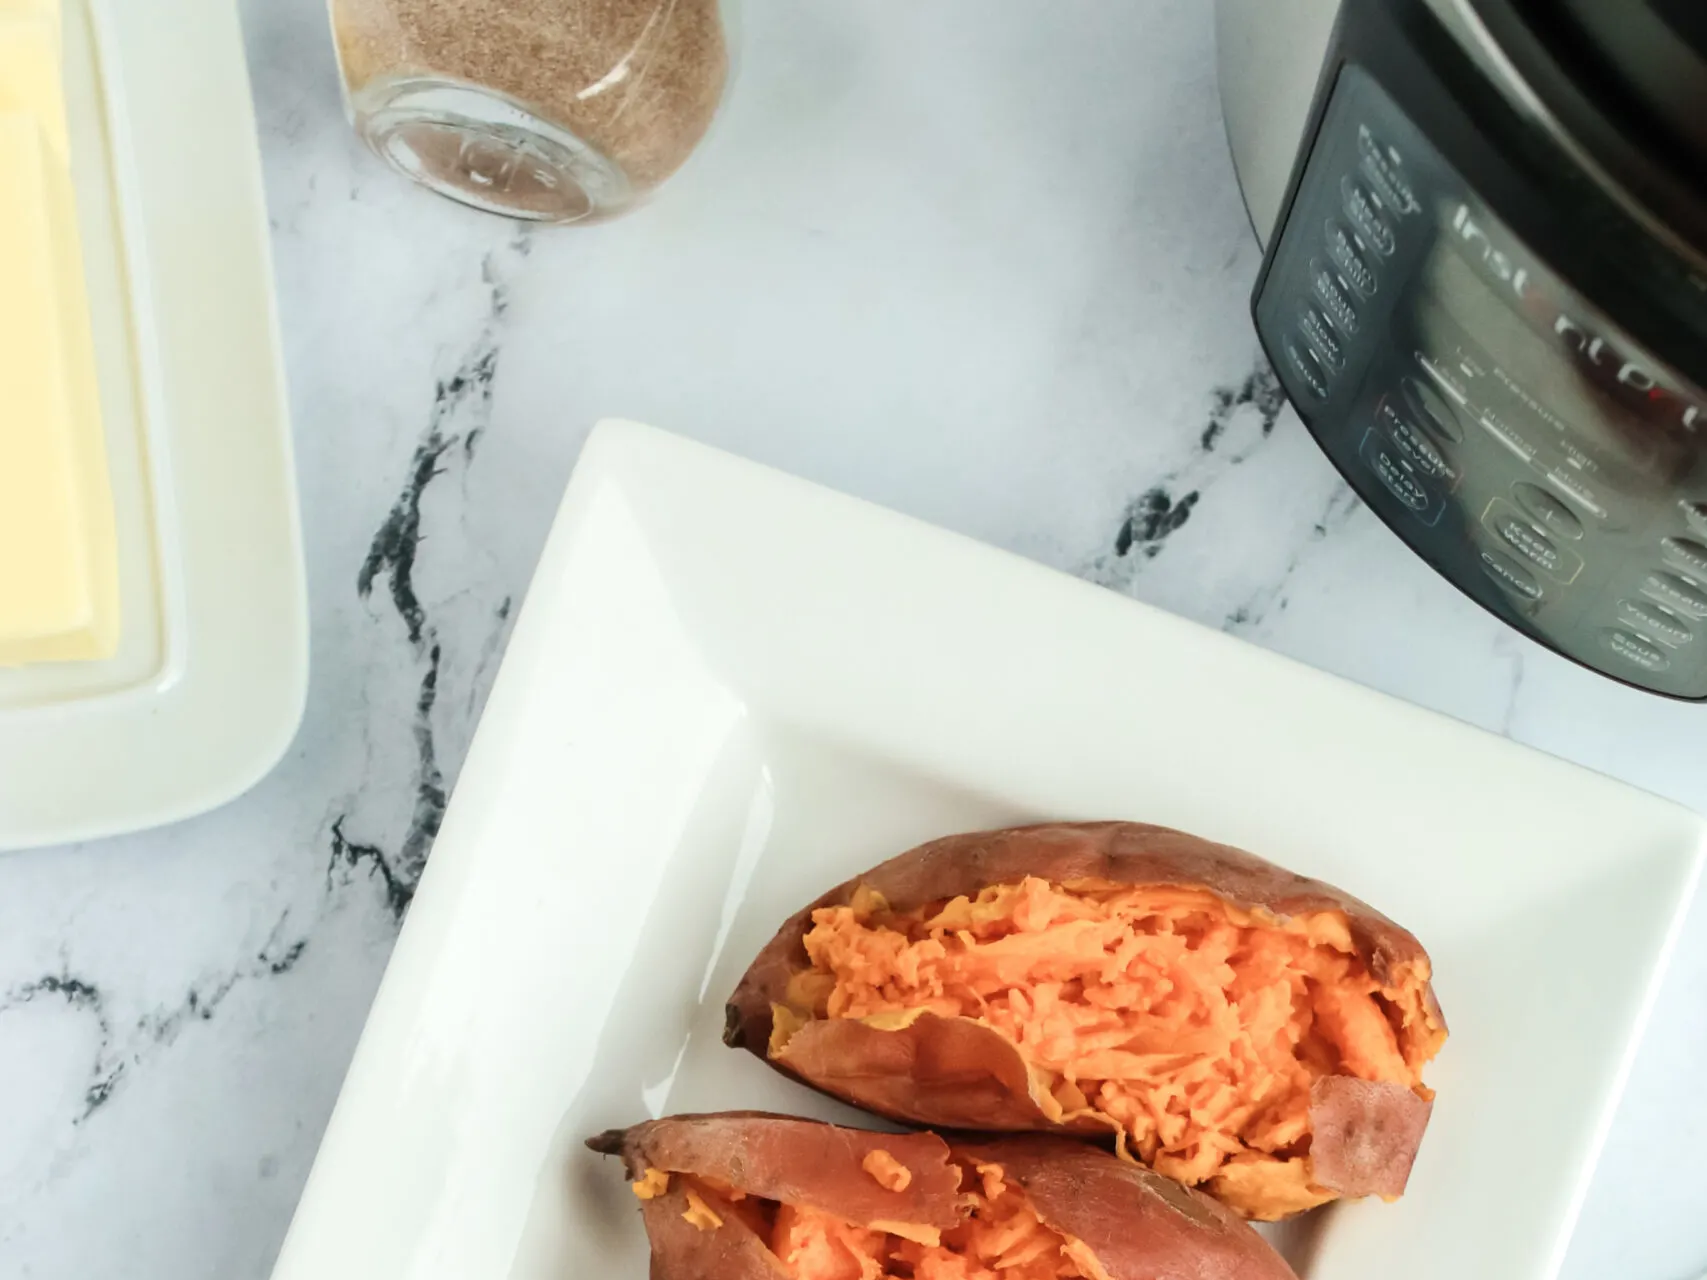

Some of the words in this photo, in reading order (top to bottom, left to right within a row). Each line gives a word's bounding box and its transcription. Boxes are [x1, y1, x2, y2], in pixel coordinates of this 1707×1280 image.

[1308, 309, 1338, 352] Slow
[1384, 405, 1455, 478] Pressure
[1393, 430, 1436, 474] Level
[1378, 463, 1417, 507] Start
[1379, 452, 1425, 497] Delay
[1503, 528, 1553, 569] Warm
[1509, 522, 1556, 560] Keep
[1481, 552, 1543, 598] Cancel
[1626, 603, 1693, 640] Yogurt
[1610, 642, 1653, 666] Vide
[1613, 632, 1660, 660] Sous
